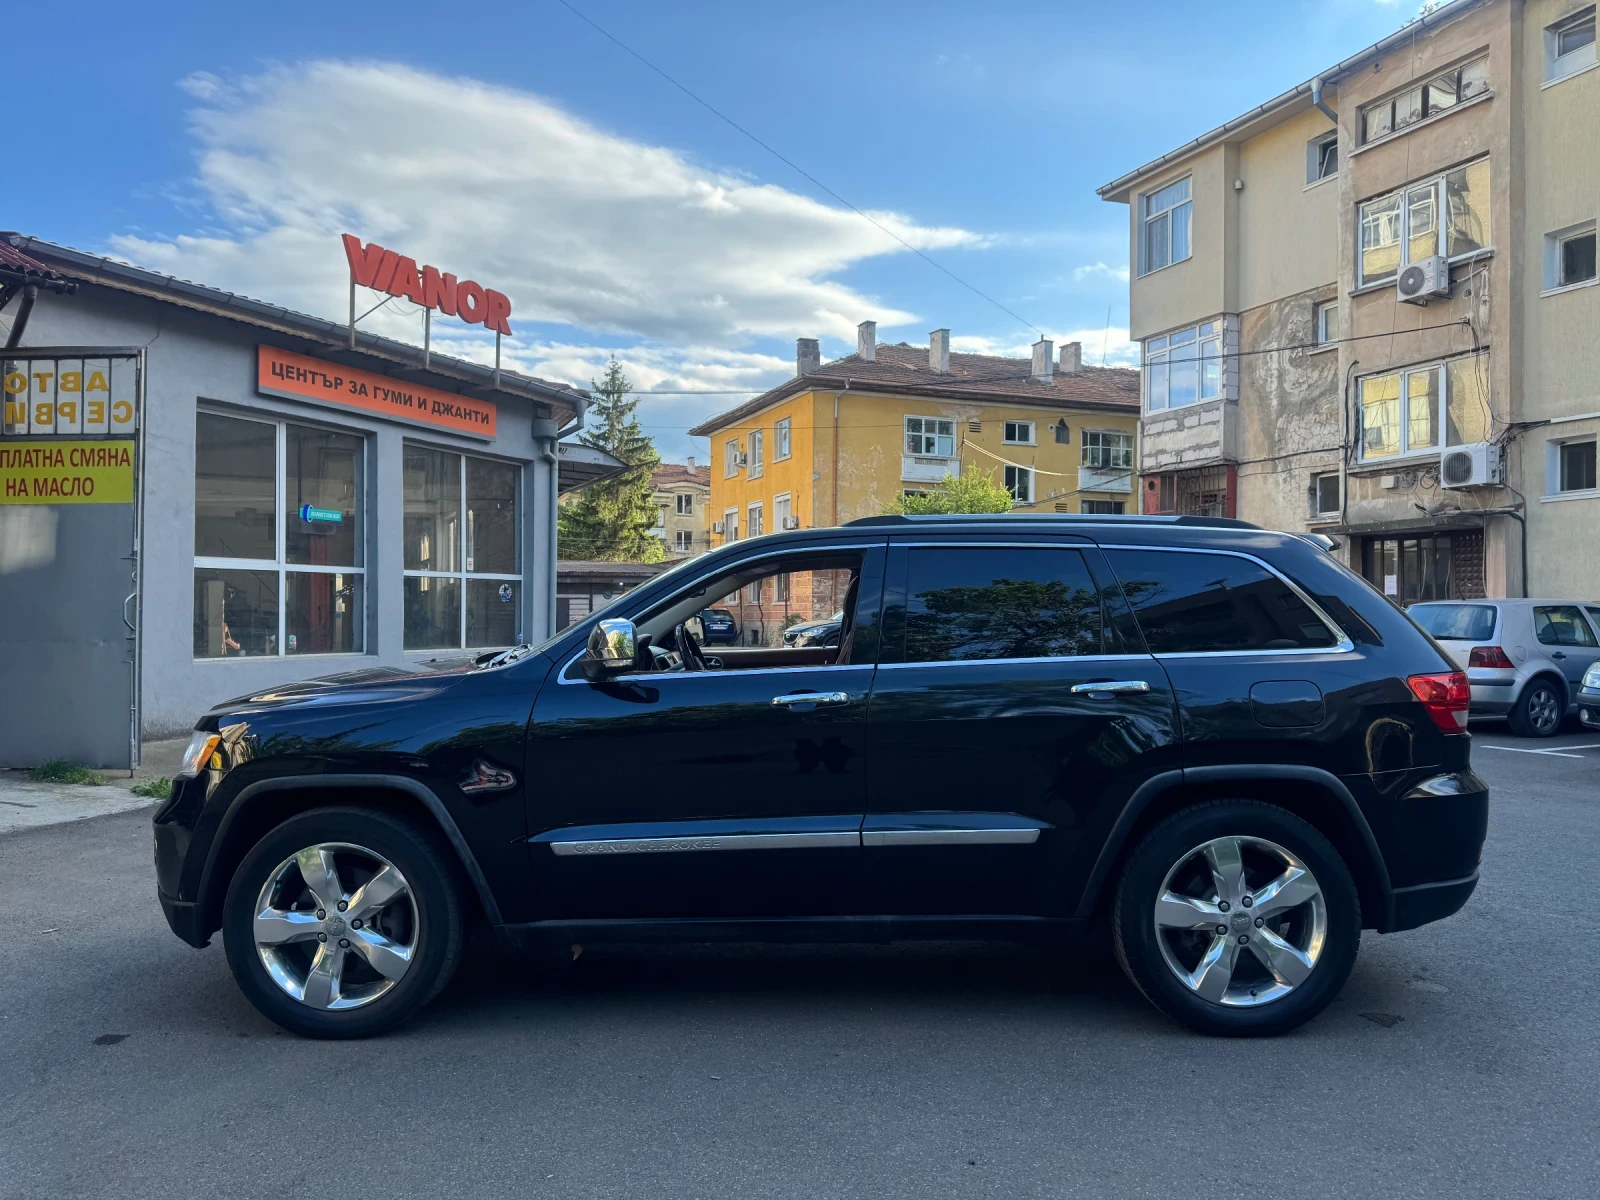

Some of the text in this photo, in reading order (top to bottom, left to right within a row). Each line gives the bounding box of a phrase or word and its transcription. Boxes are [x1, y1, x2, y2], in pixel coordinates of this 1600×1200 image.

[341, 233, 512, 336] VIANOR
[271, 361, 490, 425] ЦЕНТЪР ЗА ГУМИ И ДЖАНТИ
[69, 447, 131, 467] СМЯНА
[6, 477, 94, 497] НА МАСЛО
[573, 839, 721, 853] GRAND CHEROKEE
